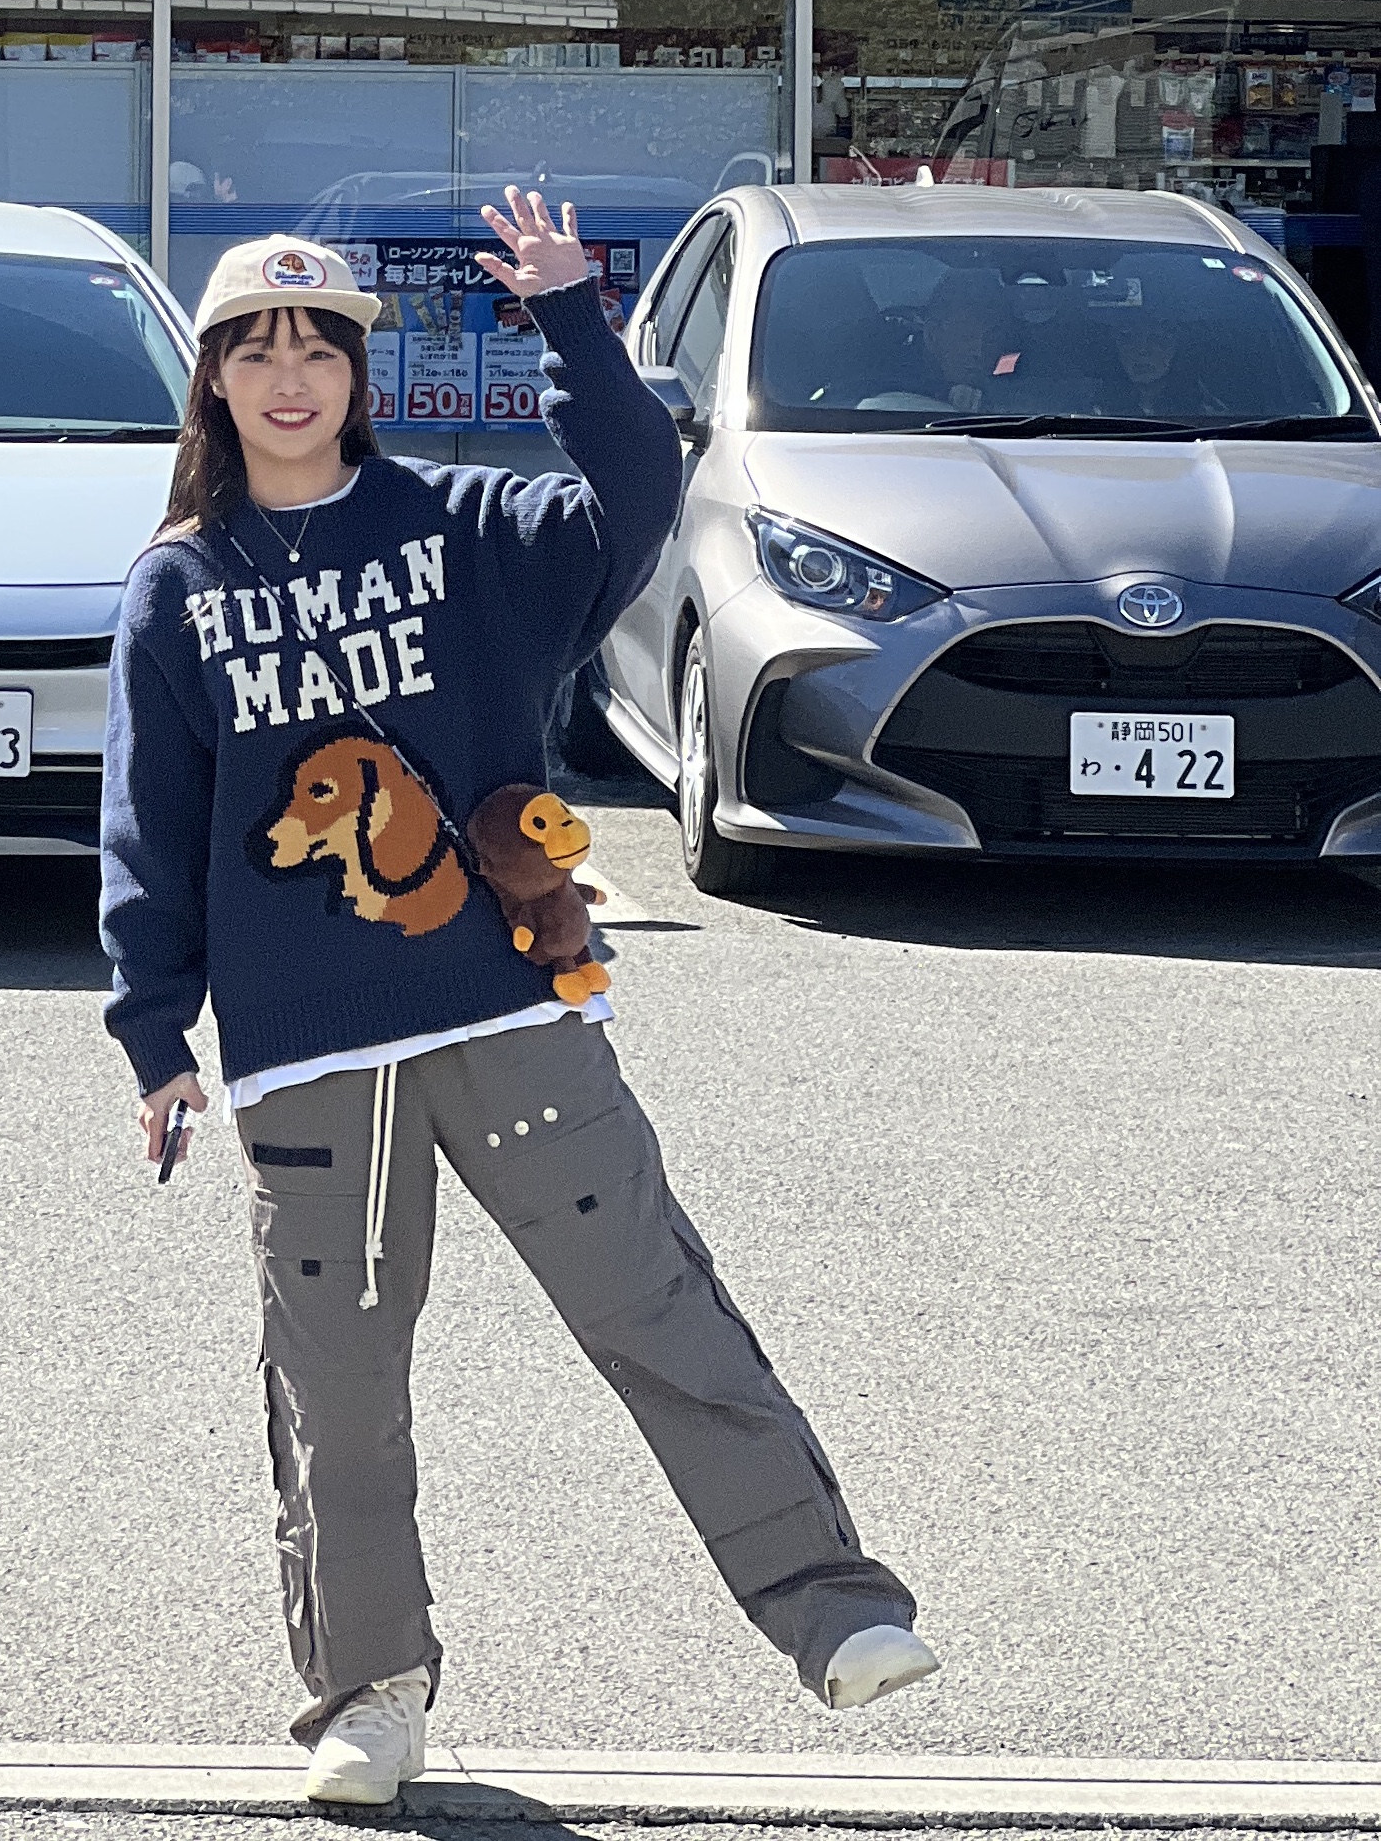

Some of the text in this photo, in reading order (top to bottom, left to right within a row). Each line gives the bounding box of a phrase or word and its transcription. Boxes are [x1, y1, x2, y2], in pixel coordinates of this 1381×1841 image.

[185, 534, 445, 662] HUMAN
[225, 616, 435, 733] MADE
[1080, 757, 1102, 776] わ
